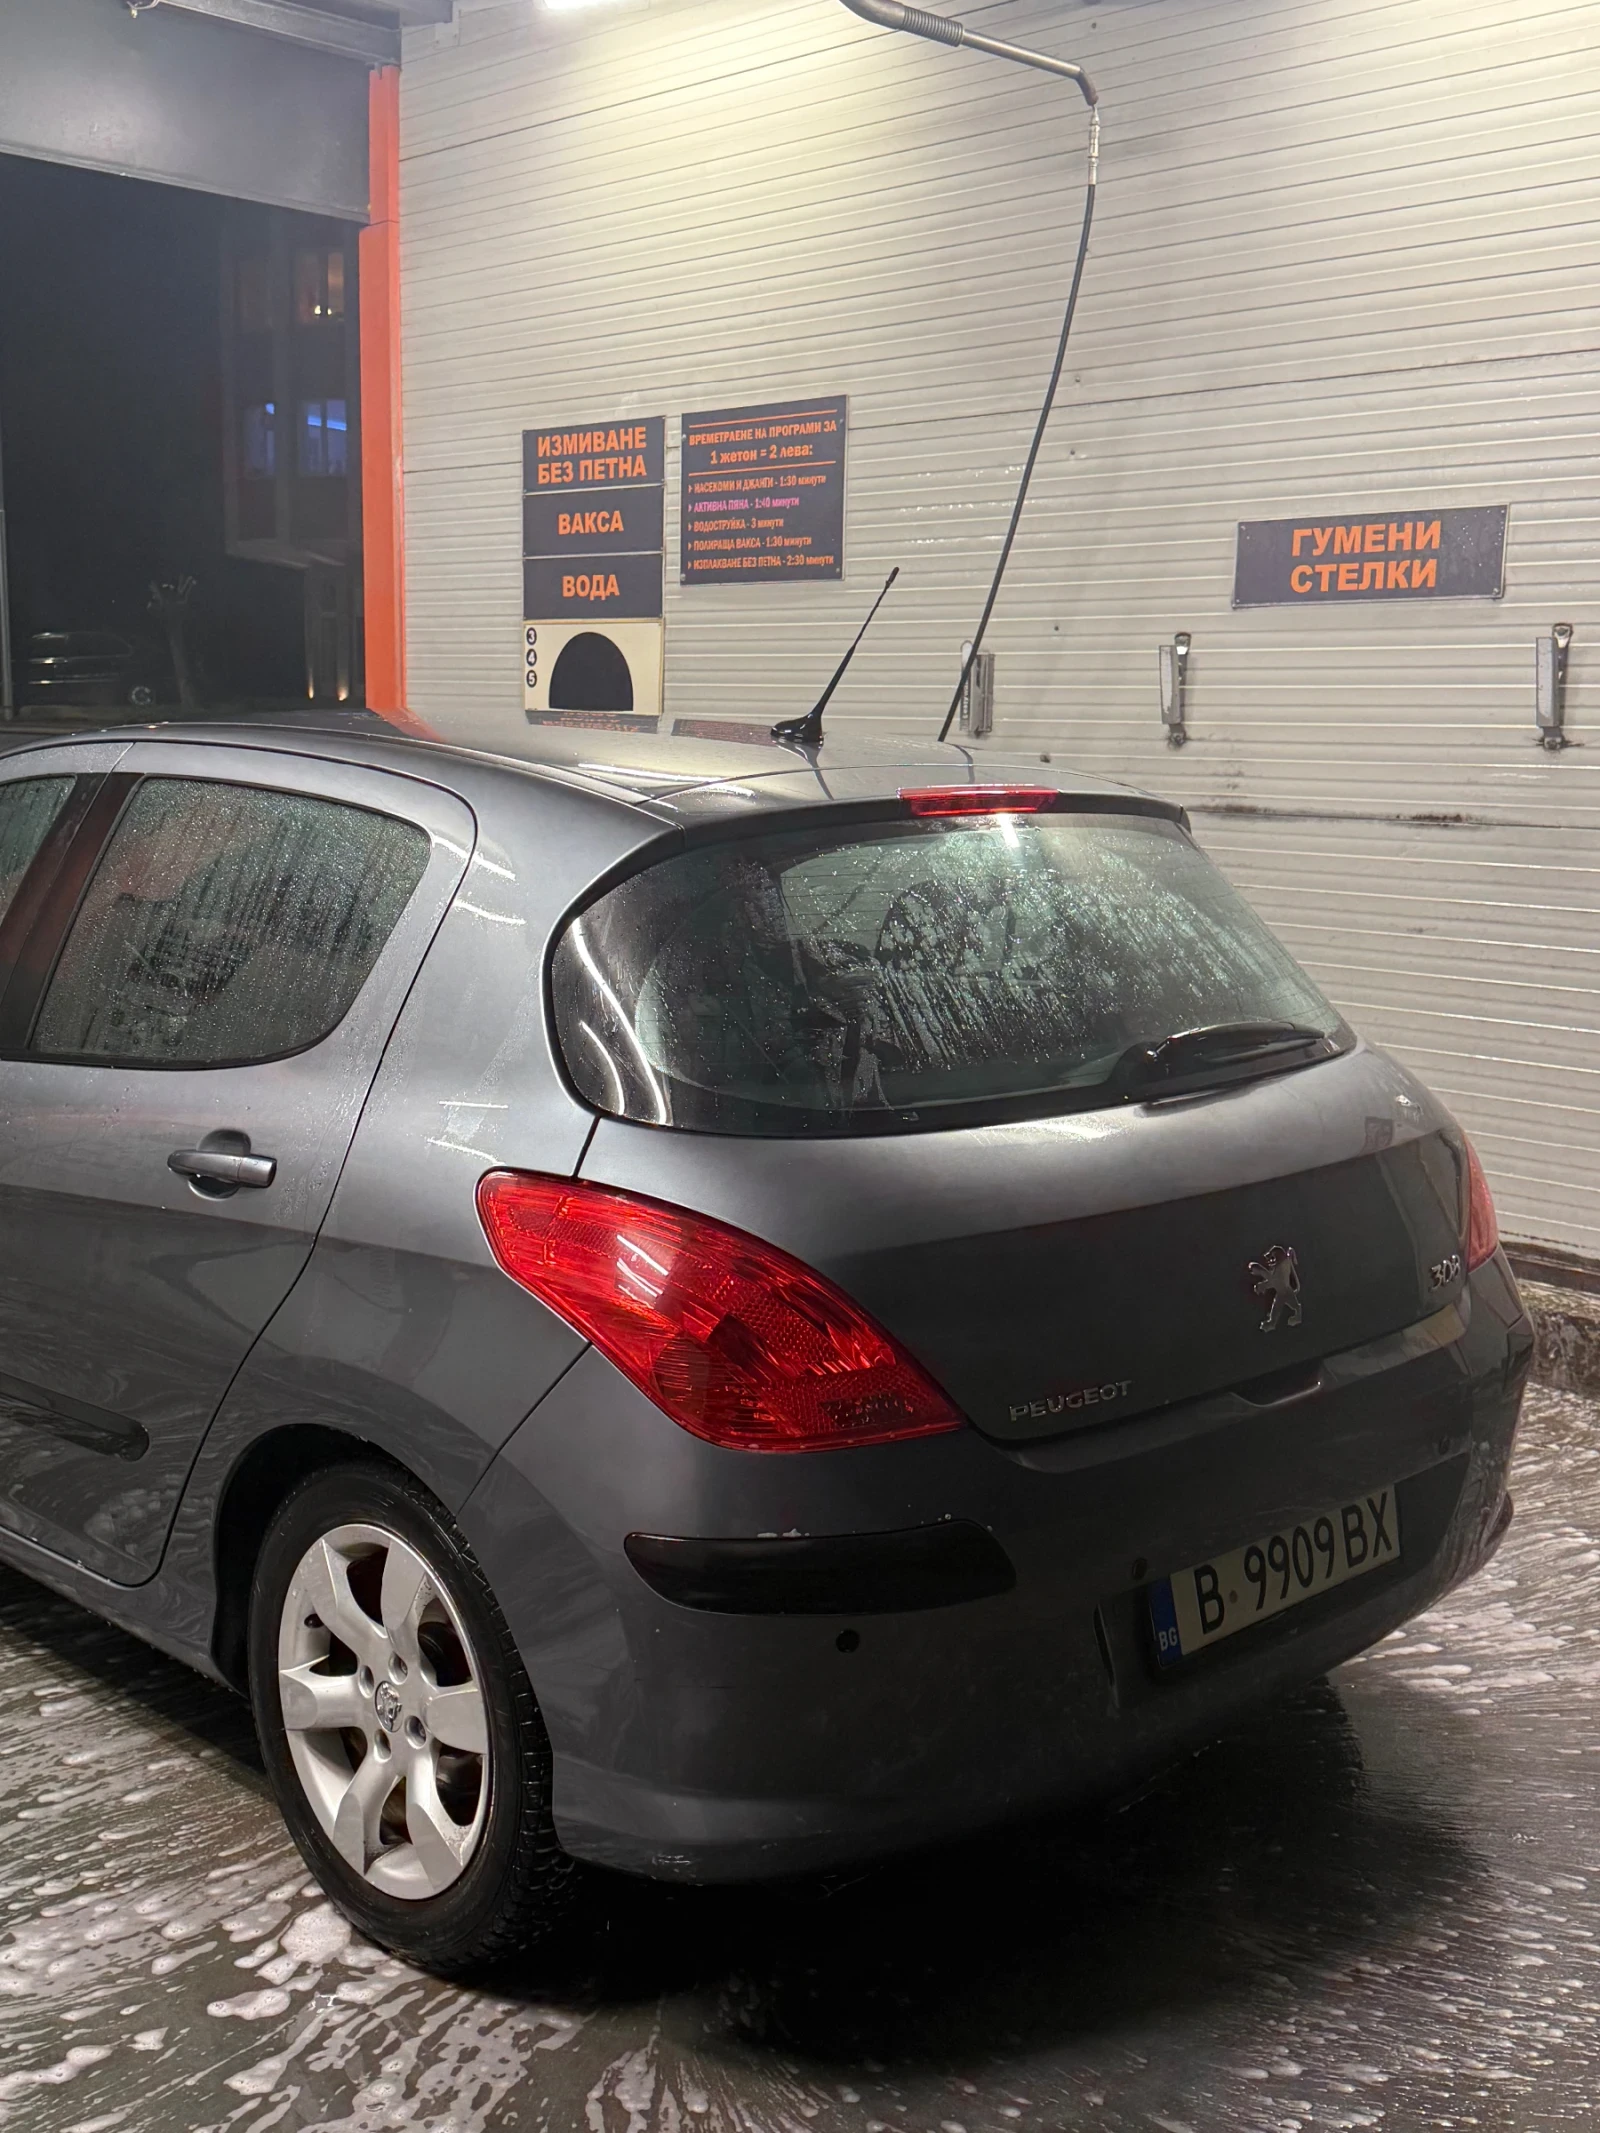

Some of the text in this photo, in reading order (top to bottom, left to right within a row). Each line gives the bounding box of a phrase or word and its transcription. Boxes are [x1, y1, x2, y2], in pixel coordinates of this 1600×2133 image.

[537, 426, 647, 458] ИЗМИВАНЕ
[689, 420, 837, 446] ВРЕМЕТРАЕНЕ НА ПРОГРАМИ ЗА
[710, 450, 718, 465] 1
[720, 450, 757, 463] жетон
[769, 444, 777, 459] 2
[779, 444, 813, 458] лева:
[537, 454, 647, 485] БЕЗ ПЕТНА
[694, 480, 735, 494] НАСЕКОМИ
[736, 480, 741, 490] И
[780, 475, 797, 488] 1:30
[798, 475, 826, 488] минути
[694, 500, 728, 513] АКТИВНА
[728, 498, 749, 511] ПЯНА
[755, 497, 771, 509] 1:40
[772, 497, 800, 509] минути
[558, 510, 624, 536] ВАКСА
[694, 517, 746, 533] ВОДОСТРУЙКА
[751, 518, 757, 529] 3
[757, 518, 784, 529] минути
[694, 538, 735, 551] ПОЛИРАЩА
[736, 537, 761, 549] ВАКСА
[783, 536, 812, 548] минути
[1291, 520, 1441, 557] ГУМЕНИ
[694, 557, 742, 570] ИЗПЛАКВАНЕ
[742, 556, 757, 568] БЕЗ
[758, 555, 782, 567] ПЕТНА
[787, 554, 805, 566] 2:30
[806, 554, 834, 567] минути
[562, 574, 620, 600] ВОДА
[1290, 558, 1438, 593] СТЕЛКИ
[528, 630, 536, 643] 3
[528, 651, 536, 663] 4
[528, 672, 536, 685] 5
[1430, 1254, 1461, 1290] 308
[1009, 1380, 1132, 1422] PEUGEOT
[1244, 1516, 1335, 1611] 9909
[1158, 1627, 1178, 1651] BG
